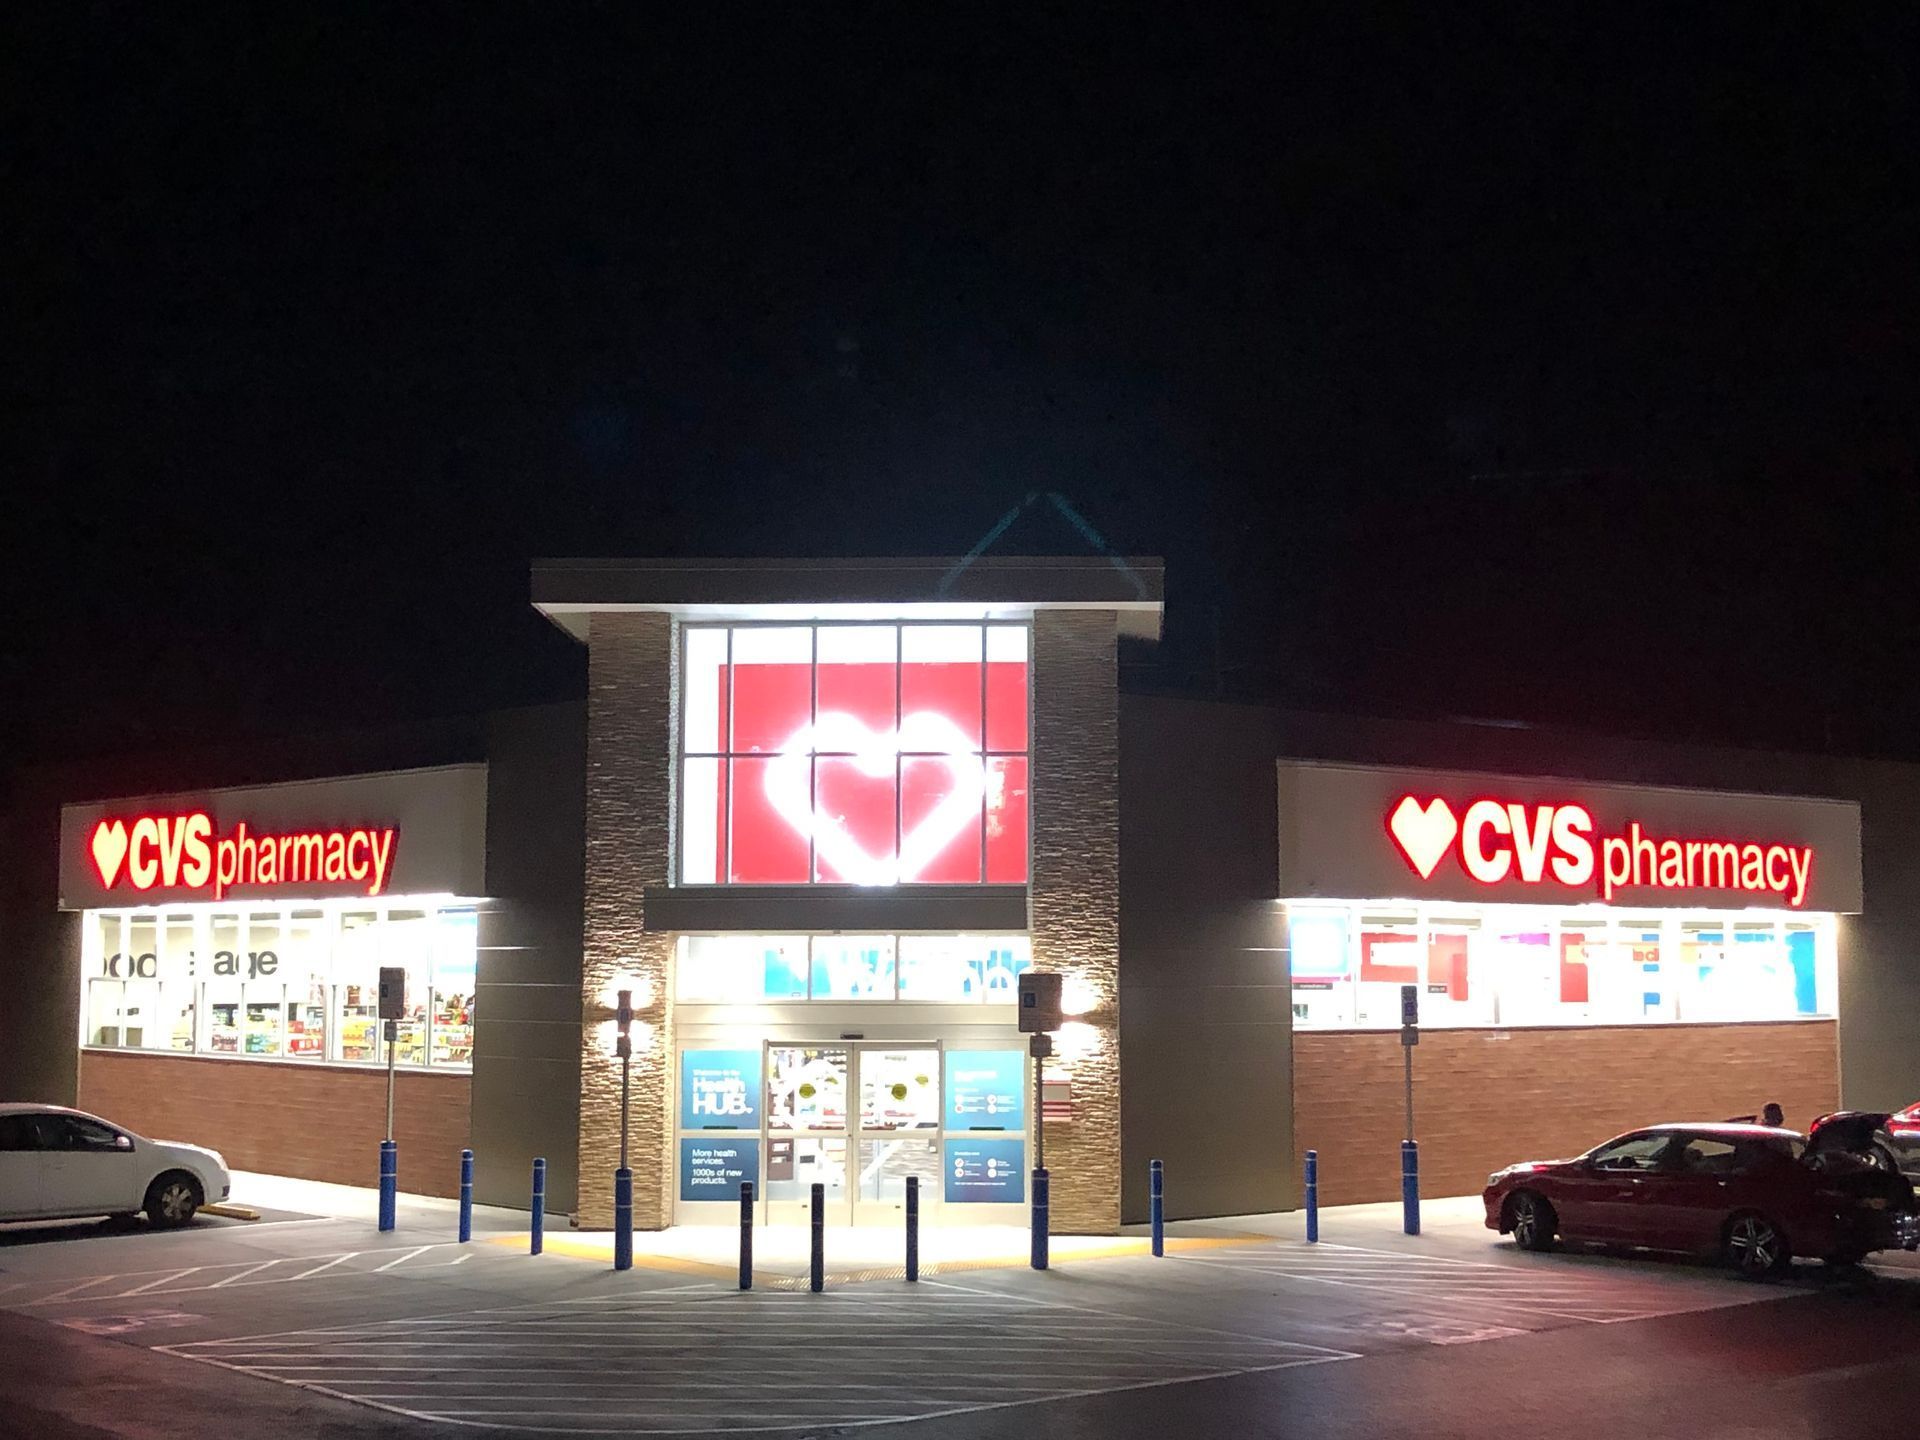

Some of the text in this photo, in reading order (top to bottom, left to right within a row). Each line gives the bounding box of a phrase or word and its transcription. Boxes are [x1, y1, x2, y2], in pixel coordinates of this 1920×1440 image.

[129, 813, 393, 901] CVS pharmacy
[1462, 800, 1813, 907] CVS pharmacy
[692, 1149, 737, 1158] More health
[693, 1169, 715, 1177] 1000s
[716, 1168, 725, 1177] of
